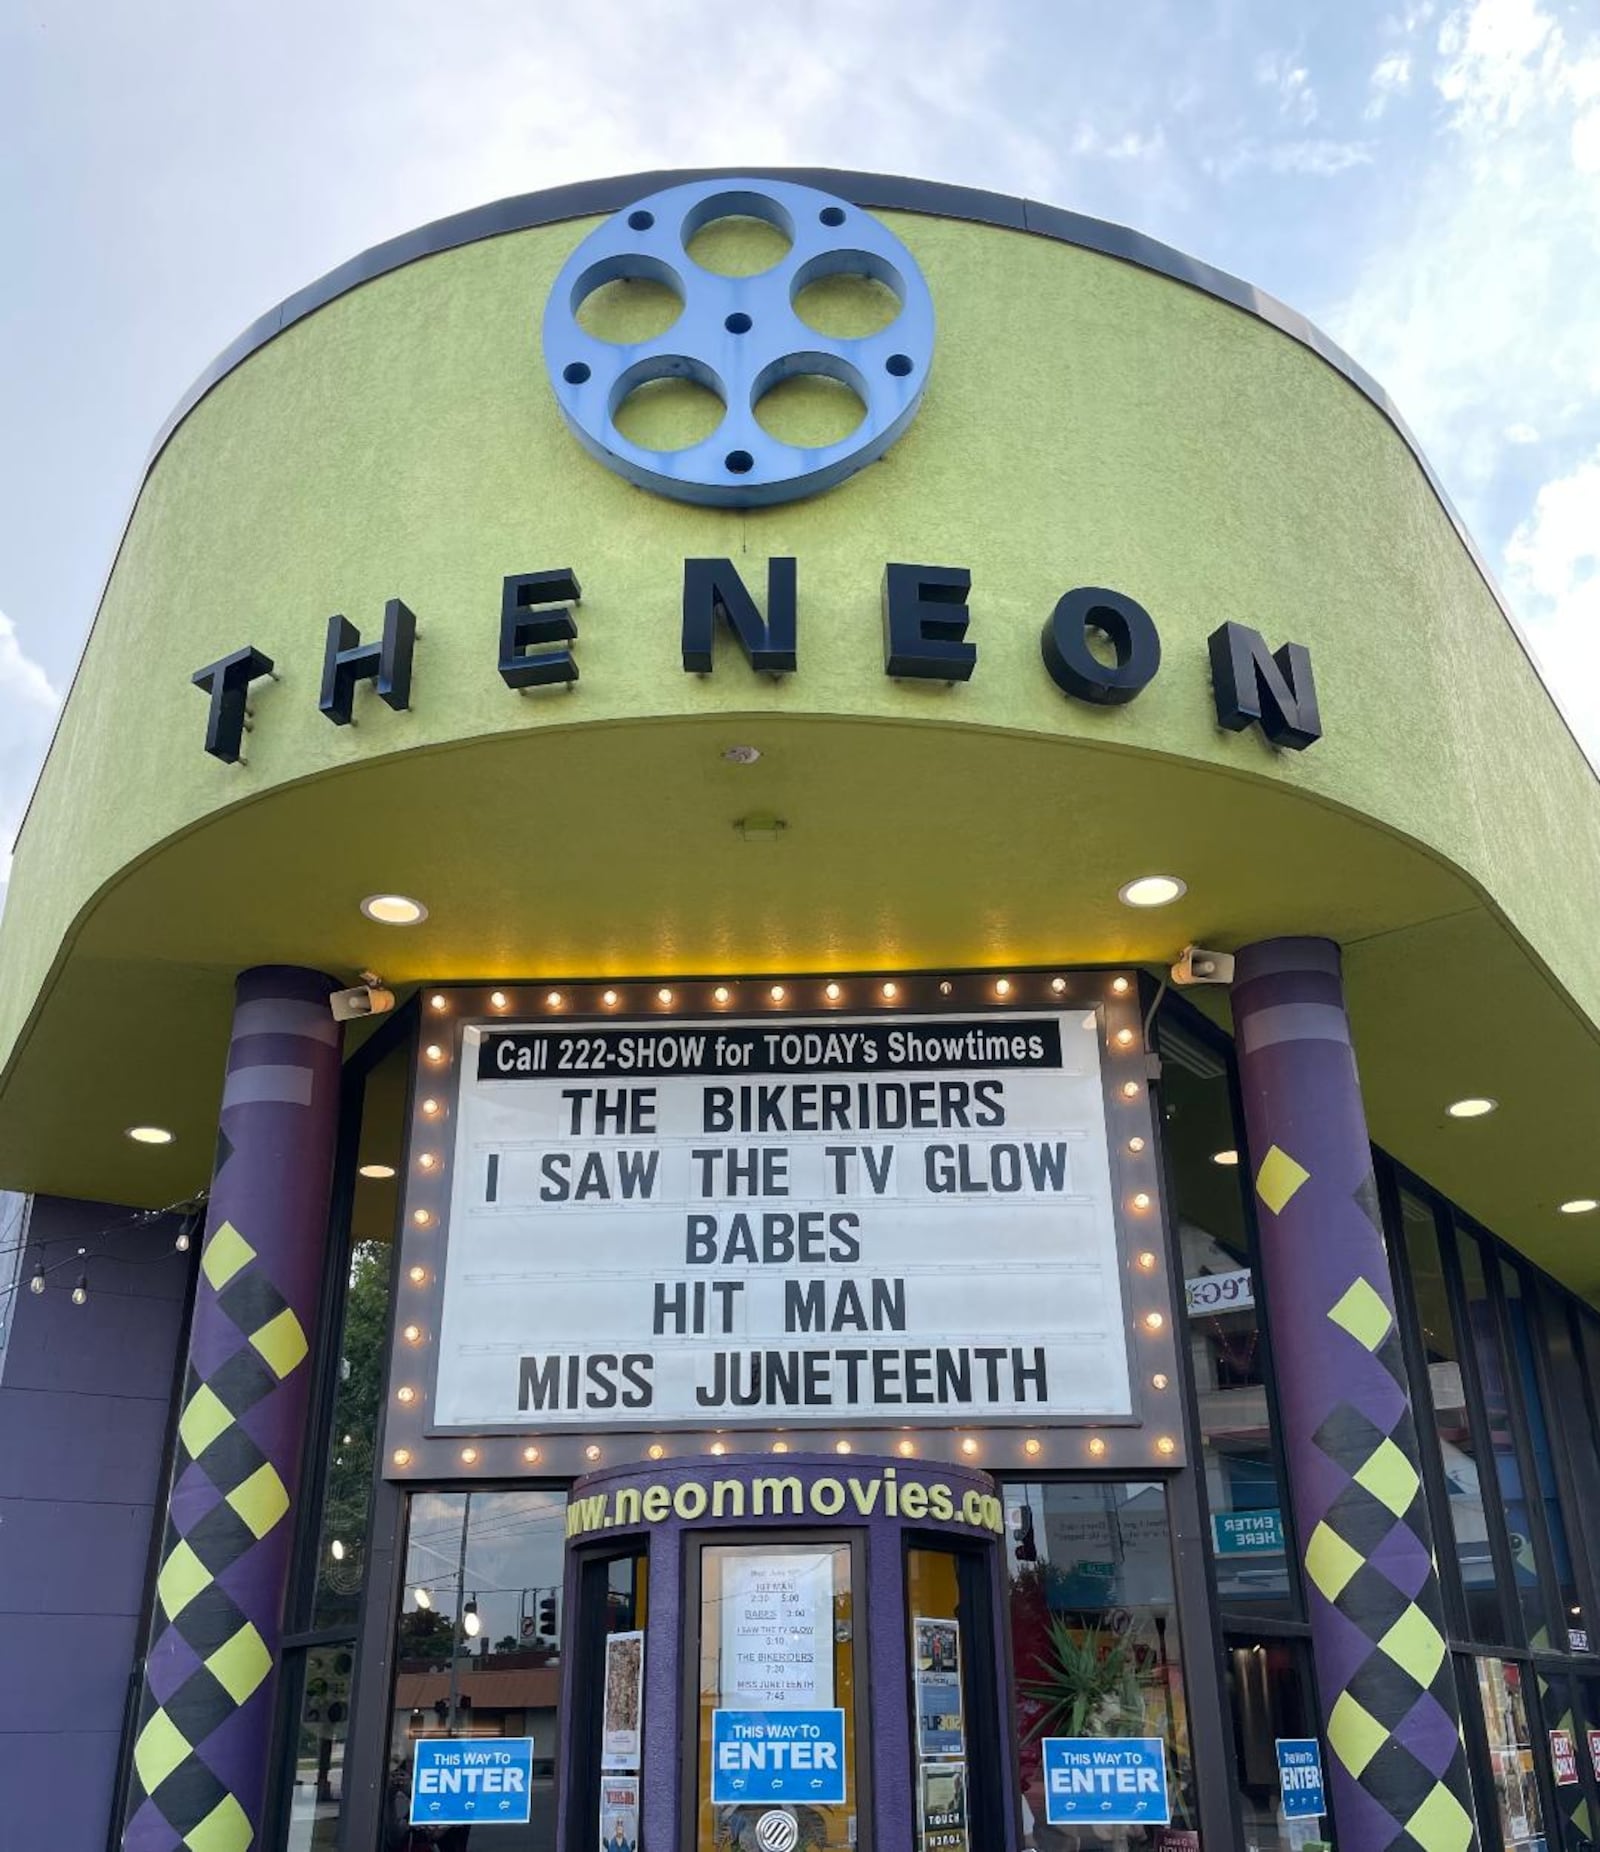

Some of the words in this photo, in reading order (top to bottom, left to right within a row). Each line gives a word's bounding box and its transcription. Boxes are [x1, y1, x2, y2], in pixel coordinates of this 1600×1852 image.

[192, 566, 583, 764] THE
[681, 556, 1322, 752] NEON
[496, 1039, 548, 1072] Call
[558, 1036, 707, 1070] 222-SHOW
[715, 1035, 754, 1067] for
[763, 1033, 879, 1066] TODAY's
[887, 1029, 1045, 1063] Showtimes
[562, 1087, 657, 1135] THE
[703, 1080, 1006, 1133] BIKERIDERS
[485, 1154, 499, 1202] I
[540, 1150, 660, 1202] SAW
[691, 1148, 789, 1198] THE
[825, 1145, 894, 1195] TV
[924, 1142, 1068, 1194] GLOW
[686, 1212, 860, 1264] BABES
[653, 1281, 744, 1335] HIT
[784, 1279, 907, 1333] MAN
[518, 1354, 655, 1411] MISS
[696, 1347, 1049, 1408] JUNETEENTH
[732, 1725, 763, 1739] THIS
[766, 1724, 798, 1739] WAY
[800, 1724, 821, 1739] TO
[433, 1753, 461, 1766] THIS
[463, 1752, 491, 1765] WAY
[493, 1752, 512, 1764] TO
[719, 1741, 838, 1770] ENTER
[1062, 1752, 1090, 1765] THIS
[1092, 1752, 1122, 1765] WAY
[1123, 1752, 1143, 1765] TO
[419, 1767, 525, 1794] ENTER
[1050, 1768, 1160, 1793] ENTER
[1281, 1766, 1321, 1790] ENTER
[928, 1812, 960, 1825] TOUCH
